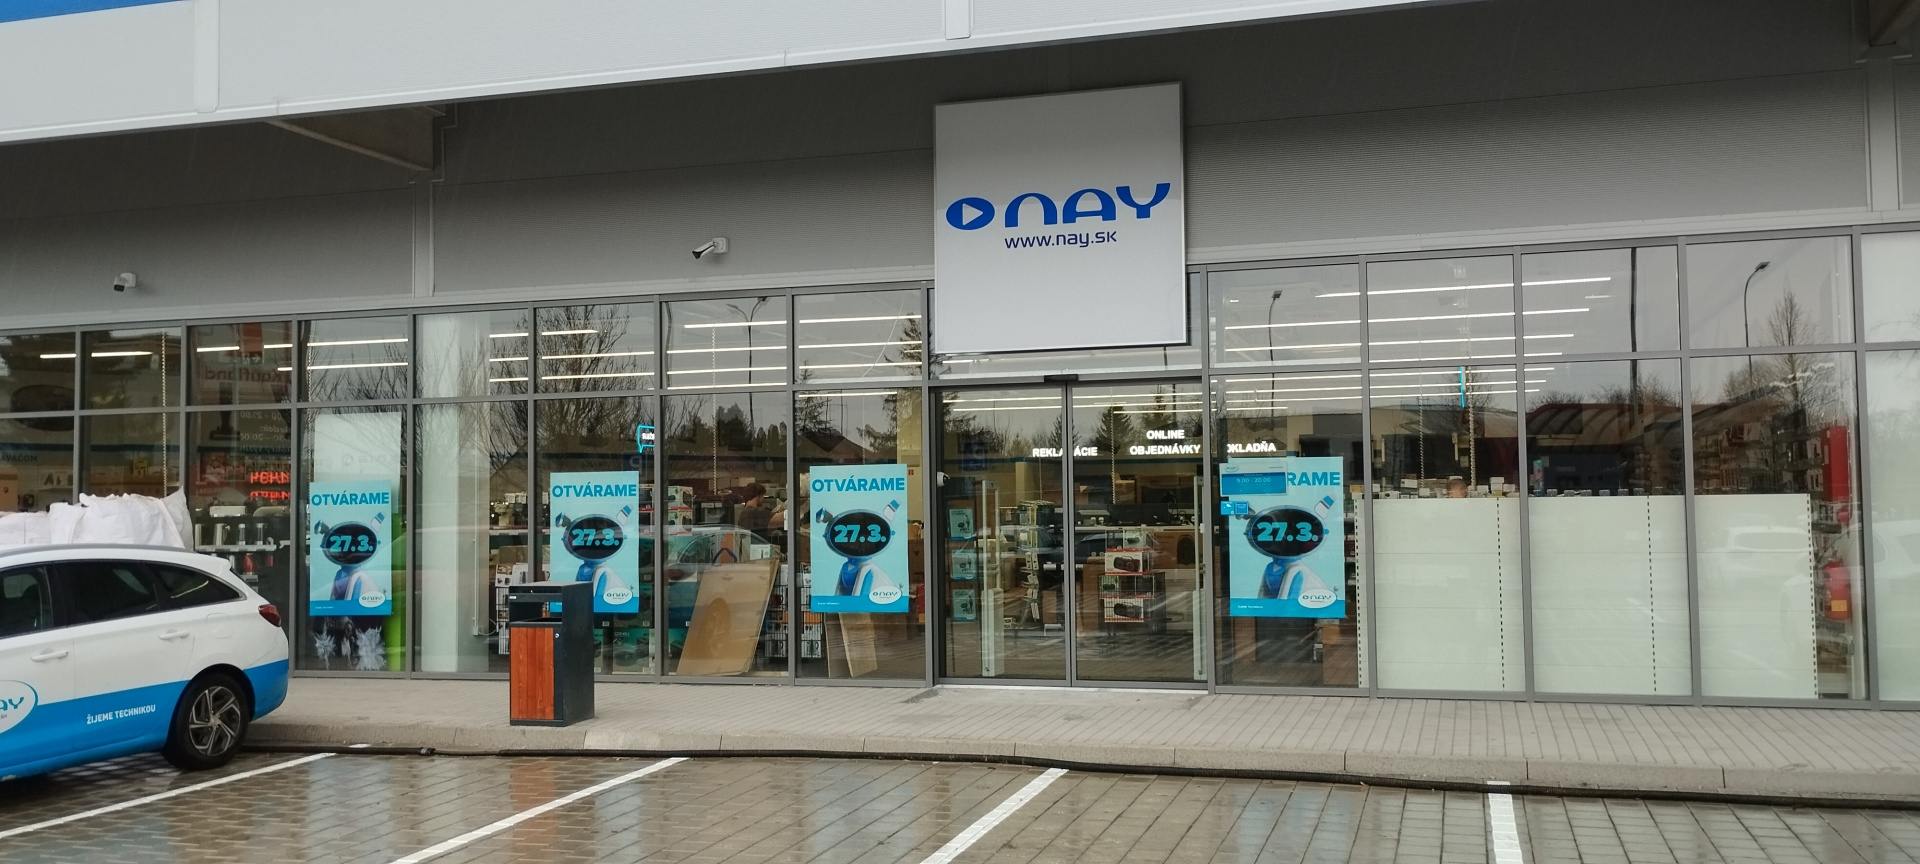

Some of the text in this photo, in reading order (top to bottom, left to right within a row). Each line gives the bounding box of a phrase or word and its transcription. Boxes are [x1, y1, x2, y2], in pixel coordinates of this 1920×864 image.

[1004, 231, 1118, 249] www.nay.sk
[1146, 429, 1185, 440] ONLINE
[1032, 445, 1098, 457] REKLAÁCIE
[1129, 443, 1201, 455] OBJEDNÁVKY
[812, 475, 905, 492] OTVÁRAME
[1287, 471, 1340, 486] RAME
[552, 481, 637, 497] OTVÁRAME
[312, 491, 389, 506] OTVÁRAME
[86, 704, 156, 725] ŽIJEME TECHNIKOU
